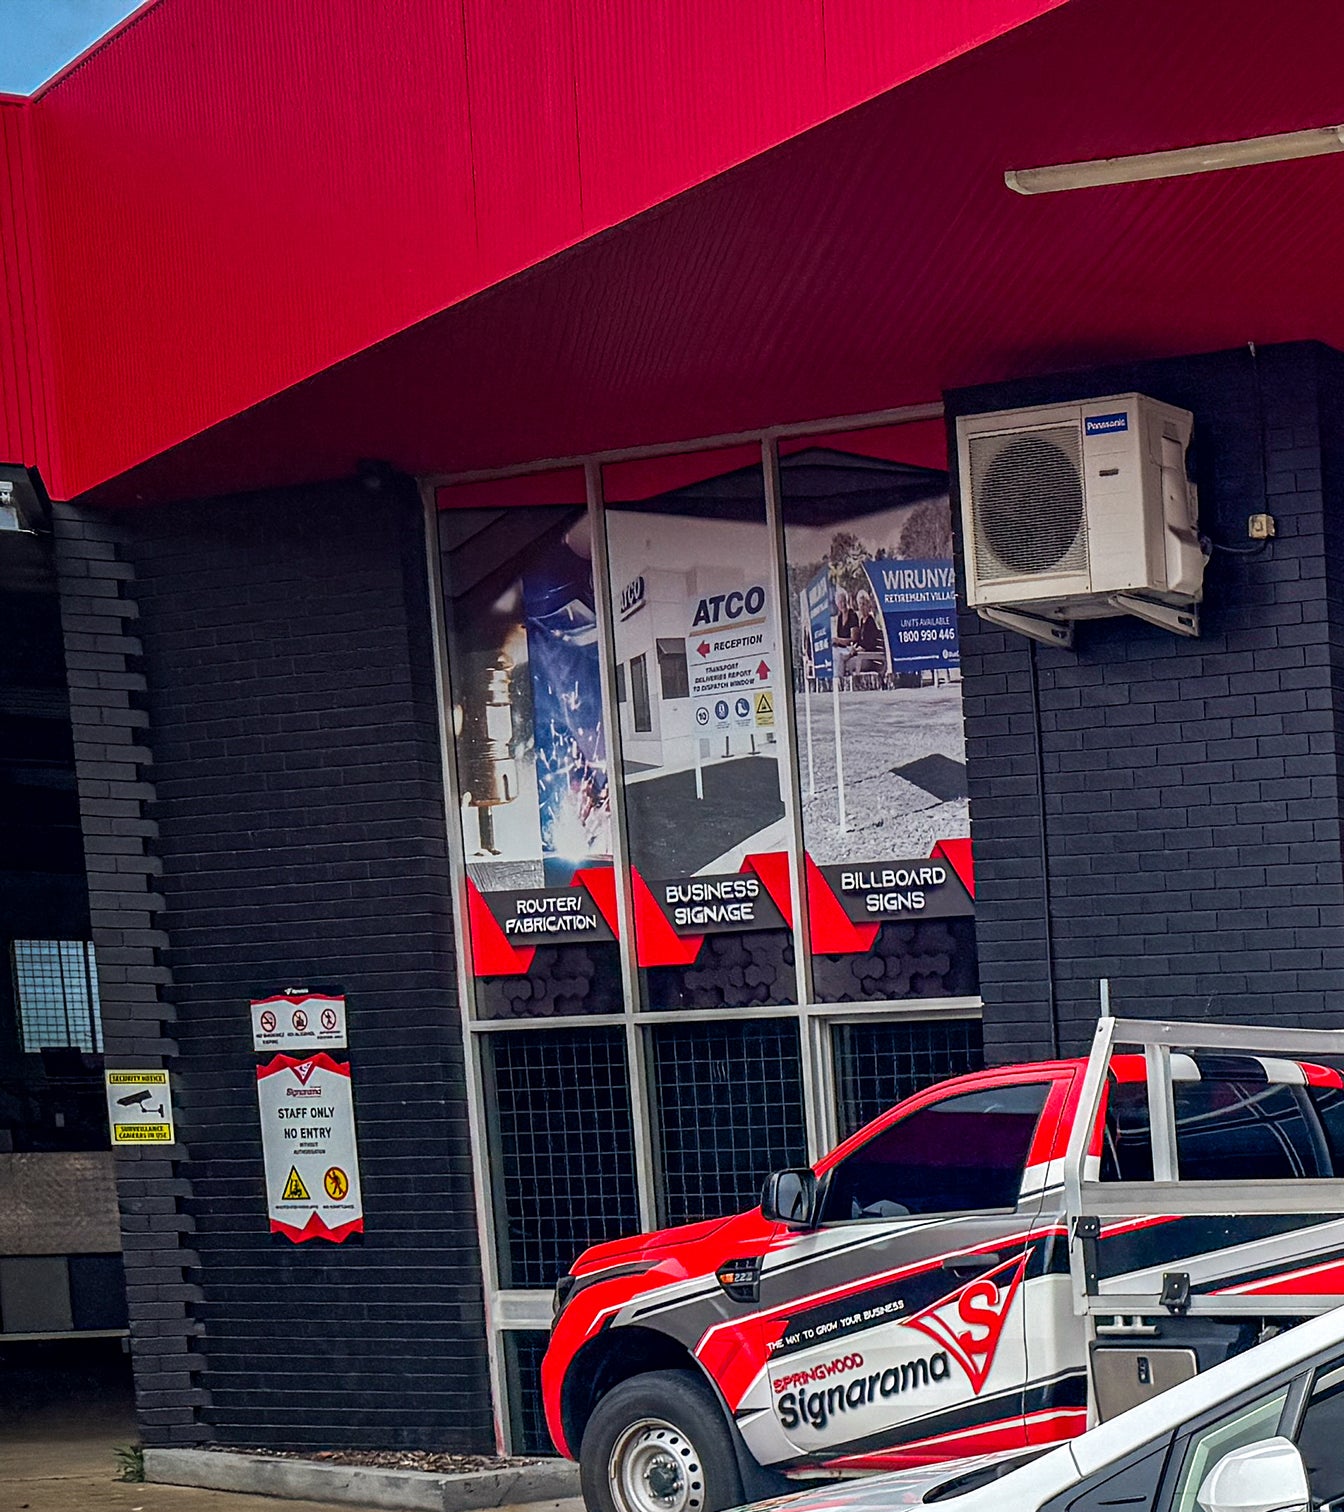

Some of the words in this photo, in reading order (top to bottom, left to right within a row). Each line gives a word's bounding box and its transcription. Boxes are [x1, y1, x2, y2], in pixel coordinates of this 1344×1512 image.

[1087, 418, 1126, 430] Panasonic
[882, 567, 956, 591] WIRUNYA
[692, 586, 765, 627] ATCO
[884, 593, 929, 604] RETIREMENT
[919, 616, 950, 627] AVAILABLE
[713, 634, 763, 652] RECEPTION
[898, 631, 919, 644] 1800
[728, 669, 752, 679] REPORT
[841, 867, 946, 890] BILLBOARD
[665, 879, 759, 903] BUSINESS
[517, 896, 582, 915] ROUTER/
[866, 891, 926, 912] SIGNS
[505, 914, 597, 934] FABRICATION
[674, 903, 755, 926] SIGNAGE
[277, 1107, 307, 1119] STAFF
[310, 1107, 335, 1119] ONLY
[284, 1127, 298, 1139] NO
[300, 1127, 332, 1139] ENTRY
[766, 1338, 784, 1352] THE
[785, 1331, 801, 1345] WAY
[802, 1328, 815, 1340] TO
[815, 1321, 838, 1336] GROW
[840, 1313, 862, 1328] YOUR
[863, 1300, 905, 1321] BUSINESS
[773, 1352, 864, 1394] SPRINGWOOD
[778, 1350, 951, 1429] Signarama
